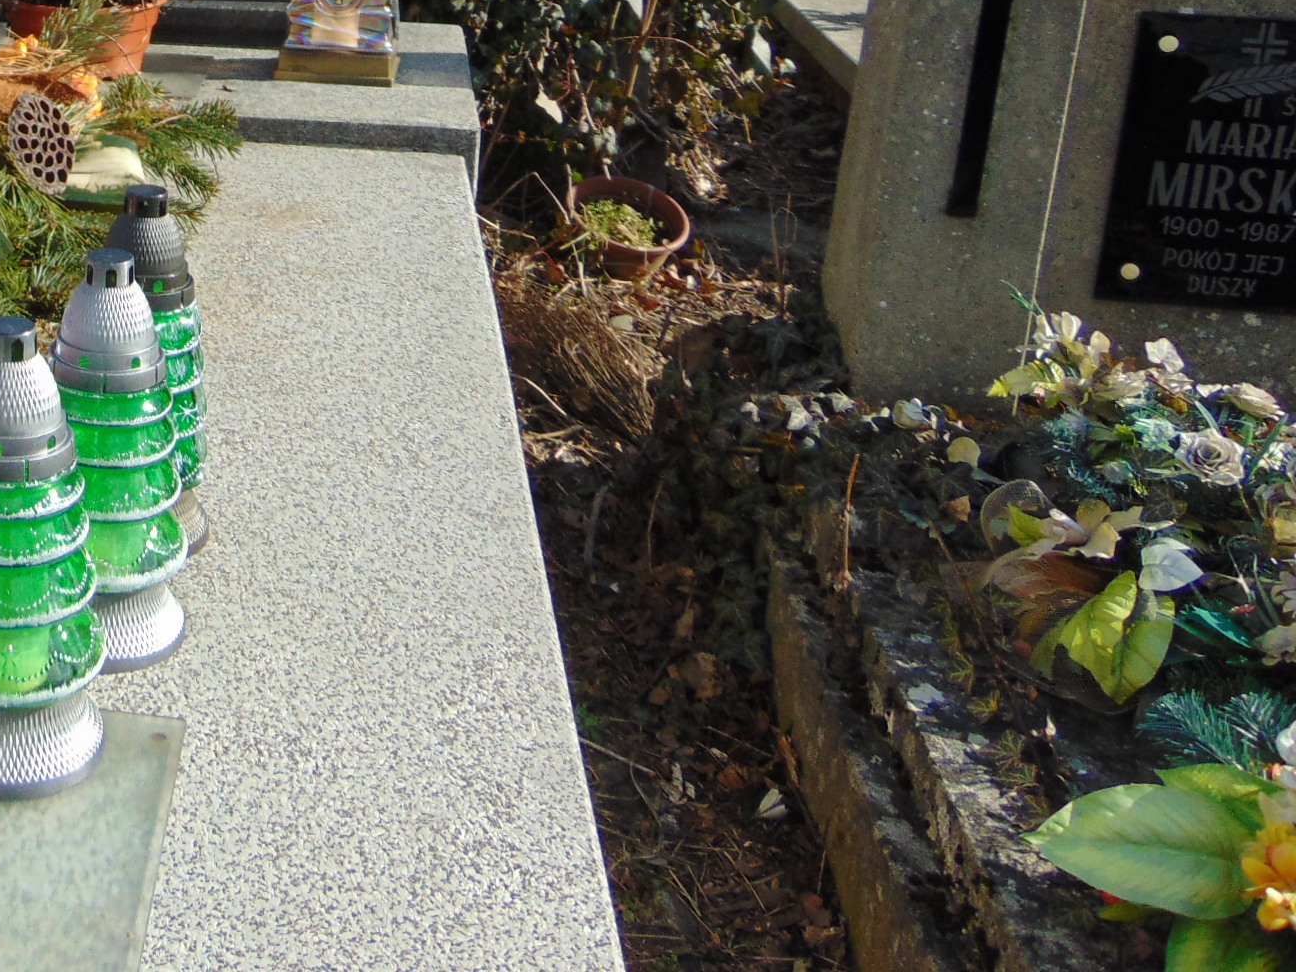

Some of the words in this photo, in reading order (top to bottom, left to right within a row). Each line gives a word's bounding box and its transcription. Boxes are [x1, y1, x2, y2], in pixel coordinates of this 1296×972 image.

[1162, 246, 1237, 273] POKÓJ
[1241, 253, 1286, 276] JEJ
[1186, 274, 1258, 298] DUSZY
